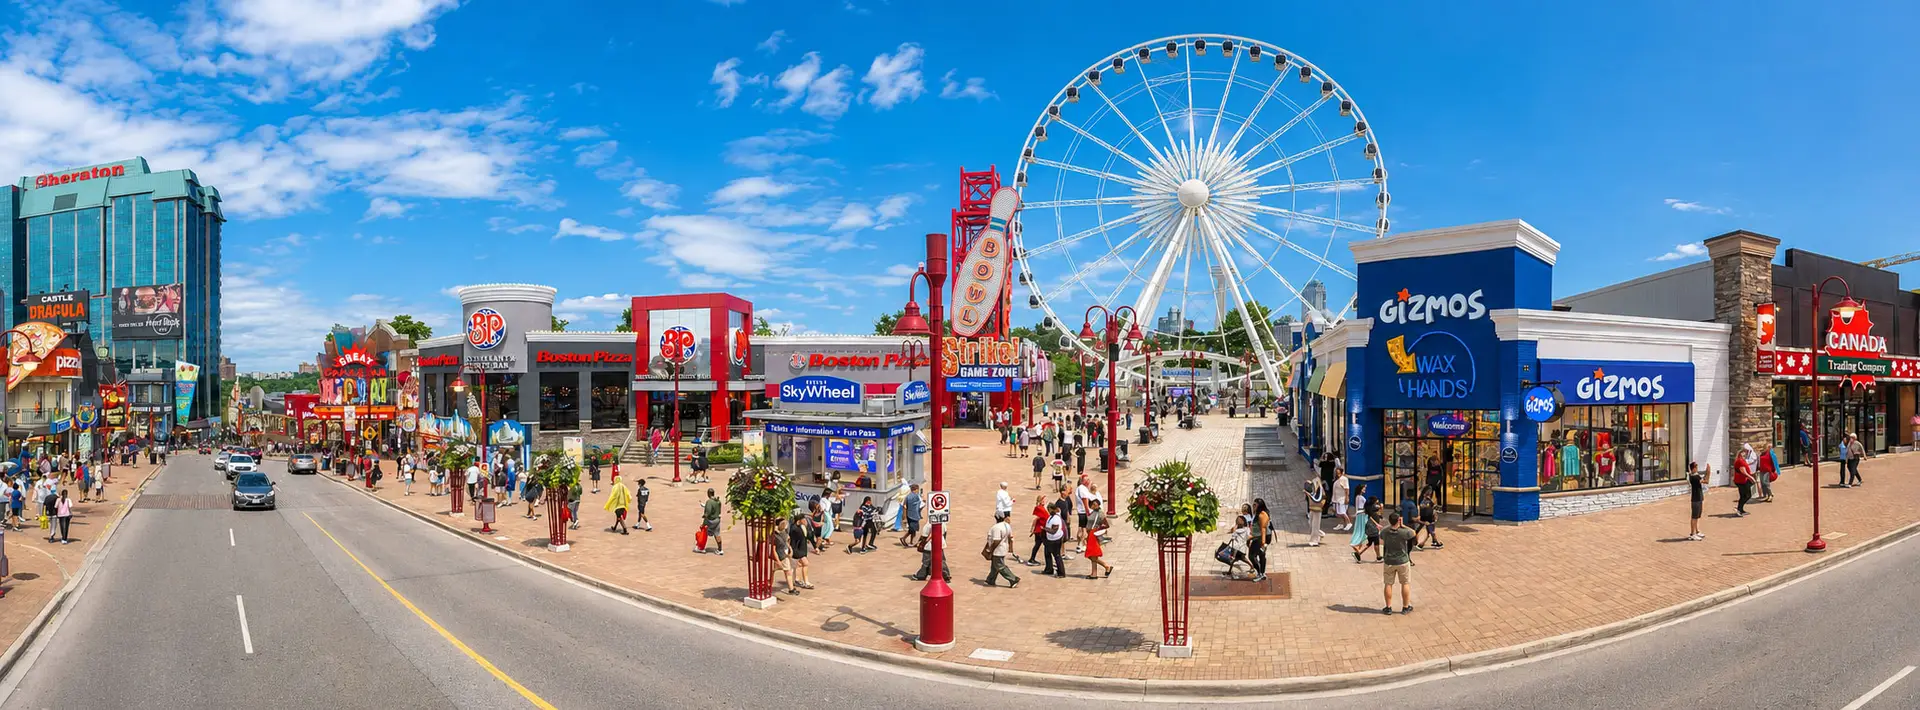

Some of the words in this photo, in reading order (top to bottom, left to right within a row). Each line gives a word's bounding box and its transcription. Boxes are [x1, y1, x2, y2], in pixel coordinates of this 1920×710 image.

[41, 294, 74, 303] CASTLE
[29, 302, 85, 319] DRACULA
[1829, 332, 1888, 353] CANADA
[56, 356, 82, 371] pizz
[338, 352, 374, 366] GREAT
[536, 350, 593, 363] Boston
[593, 350, 633, 363] Pizza
[808, 353, 880, 368] Boston
[941, 336, 1020, 378] Strike!
[1416, 354, 1457, 374] WAX
[960, 367, 988, 378] GAME
[991, 367, 1018, 378] ZONE
[1828, 359, 1857, 373] Trading
[1857, 360, 1886, 374] Company
[782, 385, 855, 401] SkyWheel
[1407, 379, 1468, 399] HANDS
[795, 426, 834, 435] Information
[843, 428, 858, 436] Fun
[858, 429, 877, 437] Pass
[1431, 421, 1465, 431] Welcome
